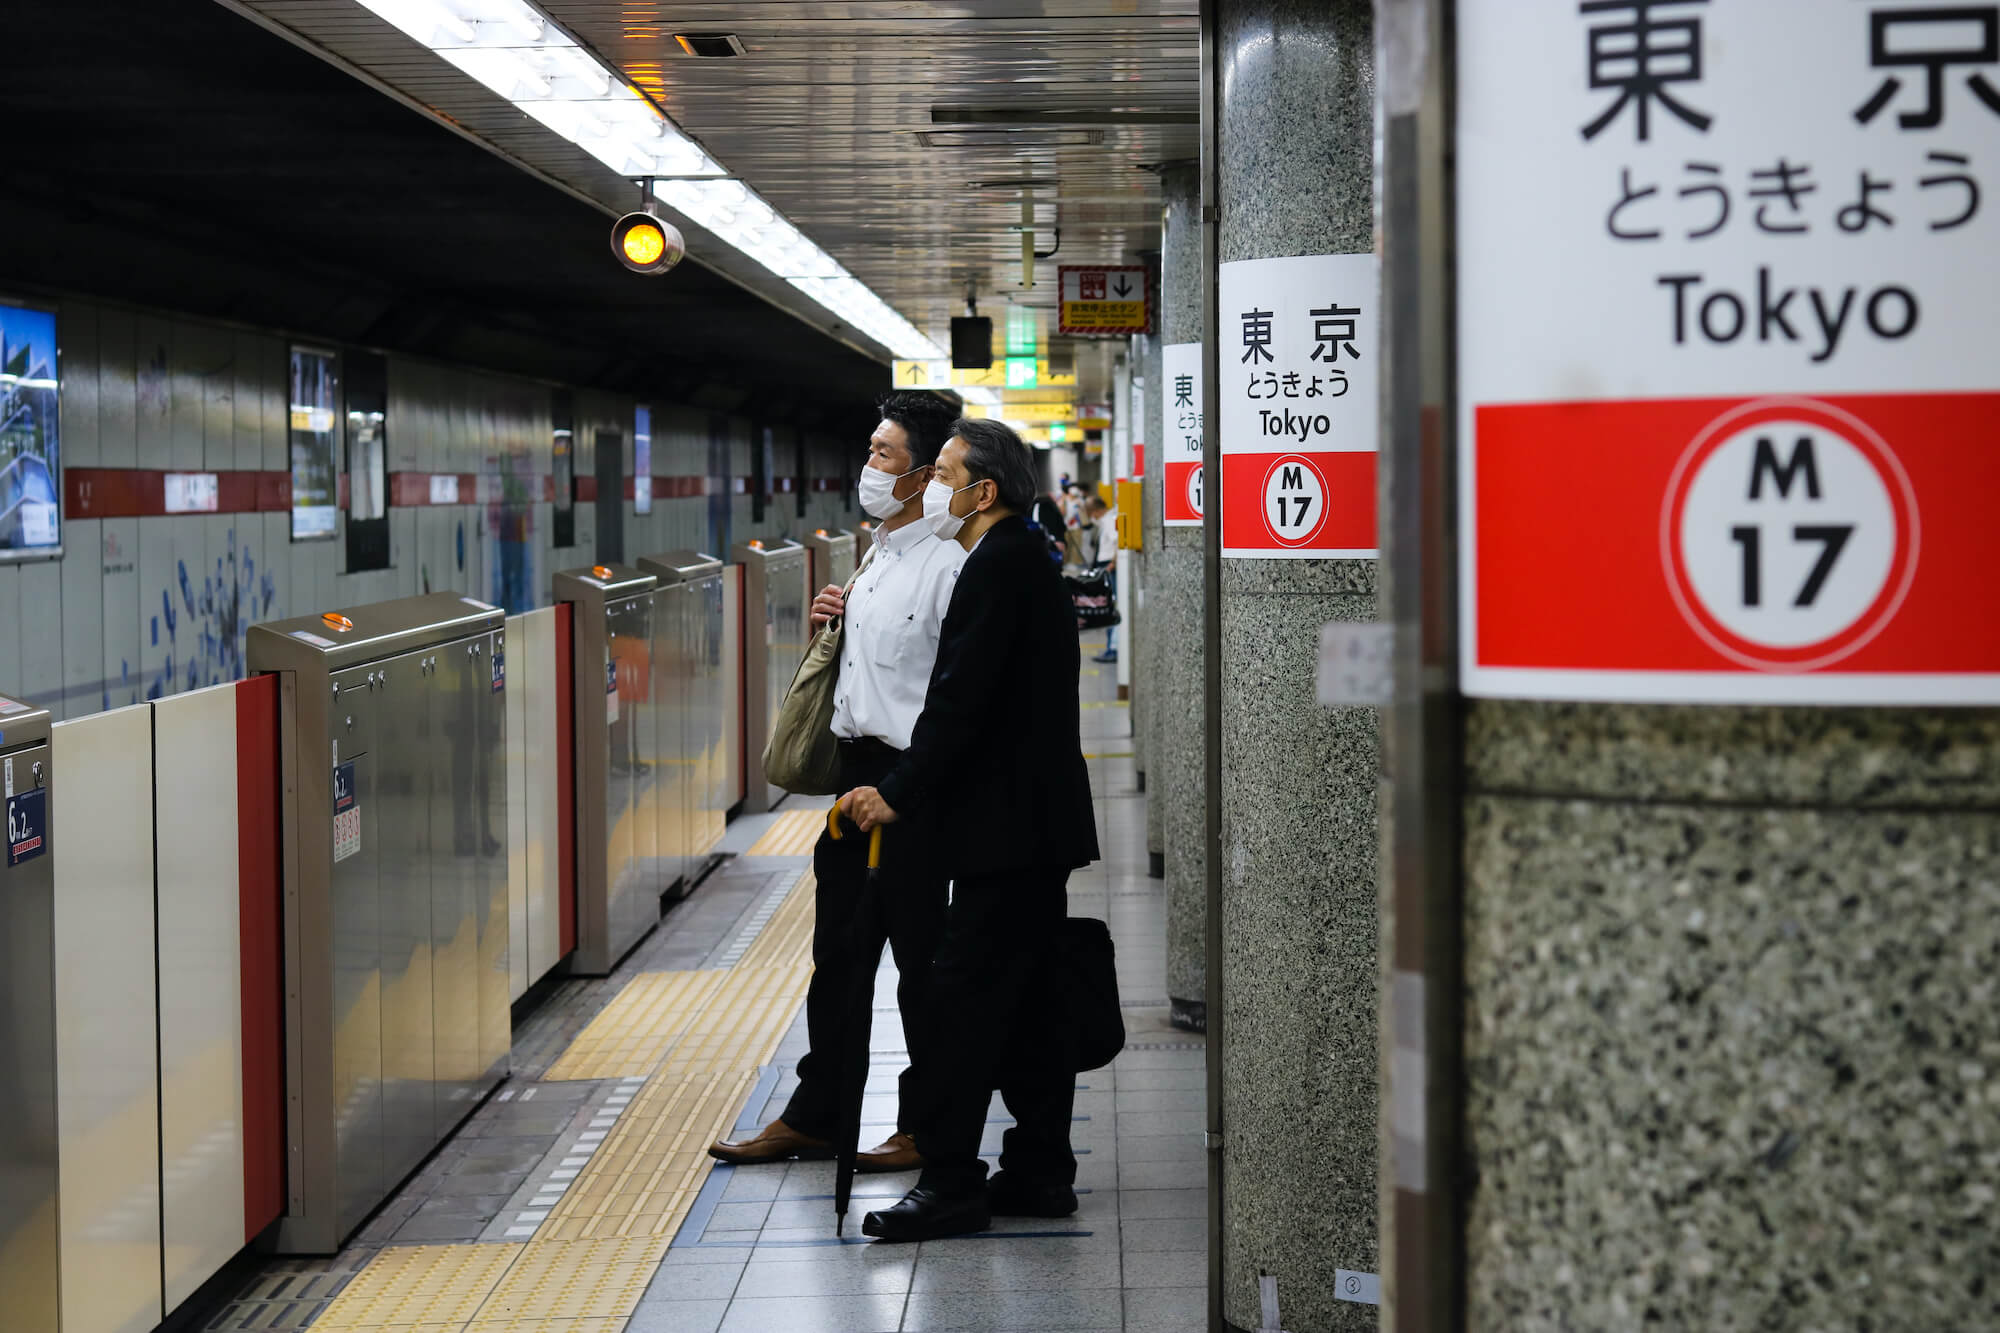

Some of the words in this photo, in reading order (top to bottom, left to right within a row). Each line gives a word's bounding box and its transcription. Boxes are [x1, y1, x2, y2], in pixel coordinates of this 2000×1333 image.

[1579, 0, 2000, 142] 東京
[1607, 151, 1981, 241] とうきょう
[1241, 304, 1361, 365] 東京
[1657, 267, 1920, 363] Tokyo
[1247, 369, 1349, 399] とうきょう
[1259, 408, 1331, 442] Tokyo
[1281, 466, 1303, 489] M
[1747, 437, 1822, 500] M
[1277, 496, 1313, 527] 17
[1731, 525, 1856, 607] 17
